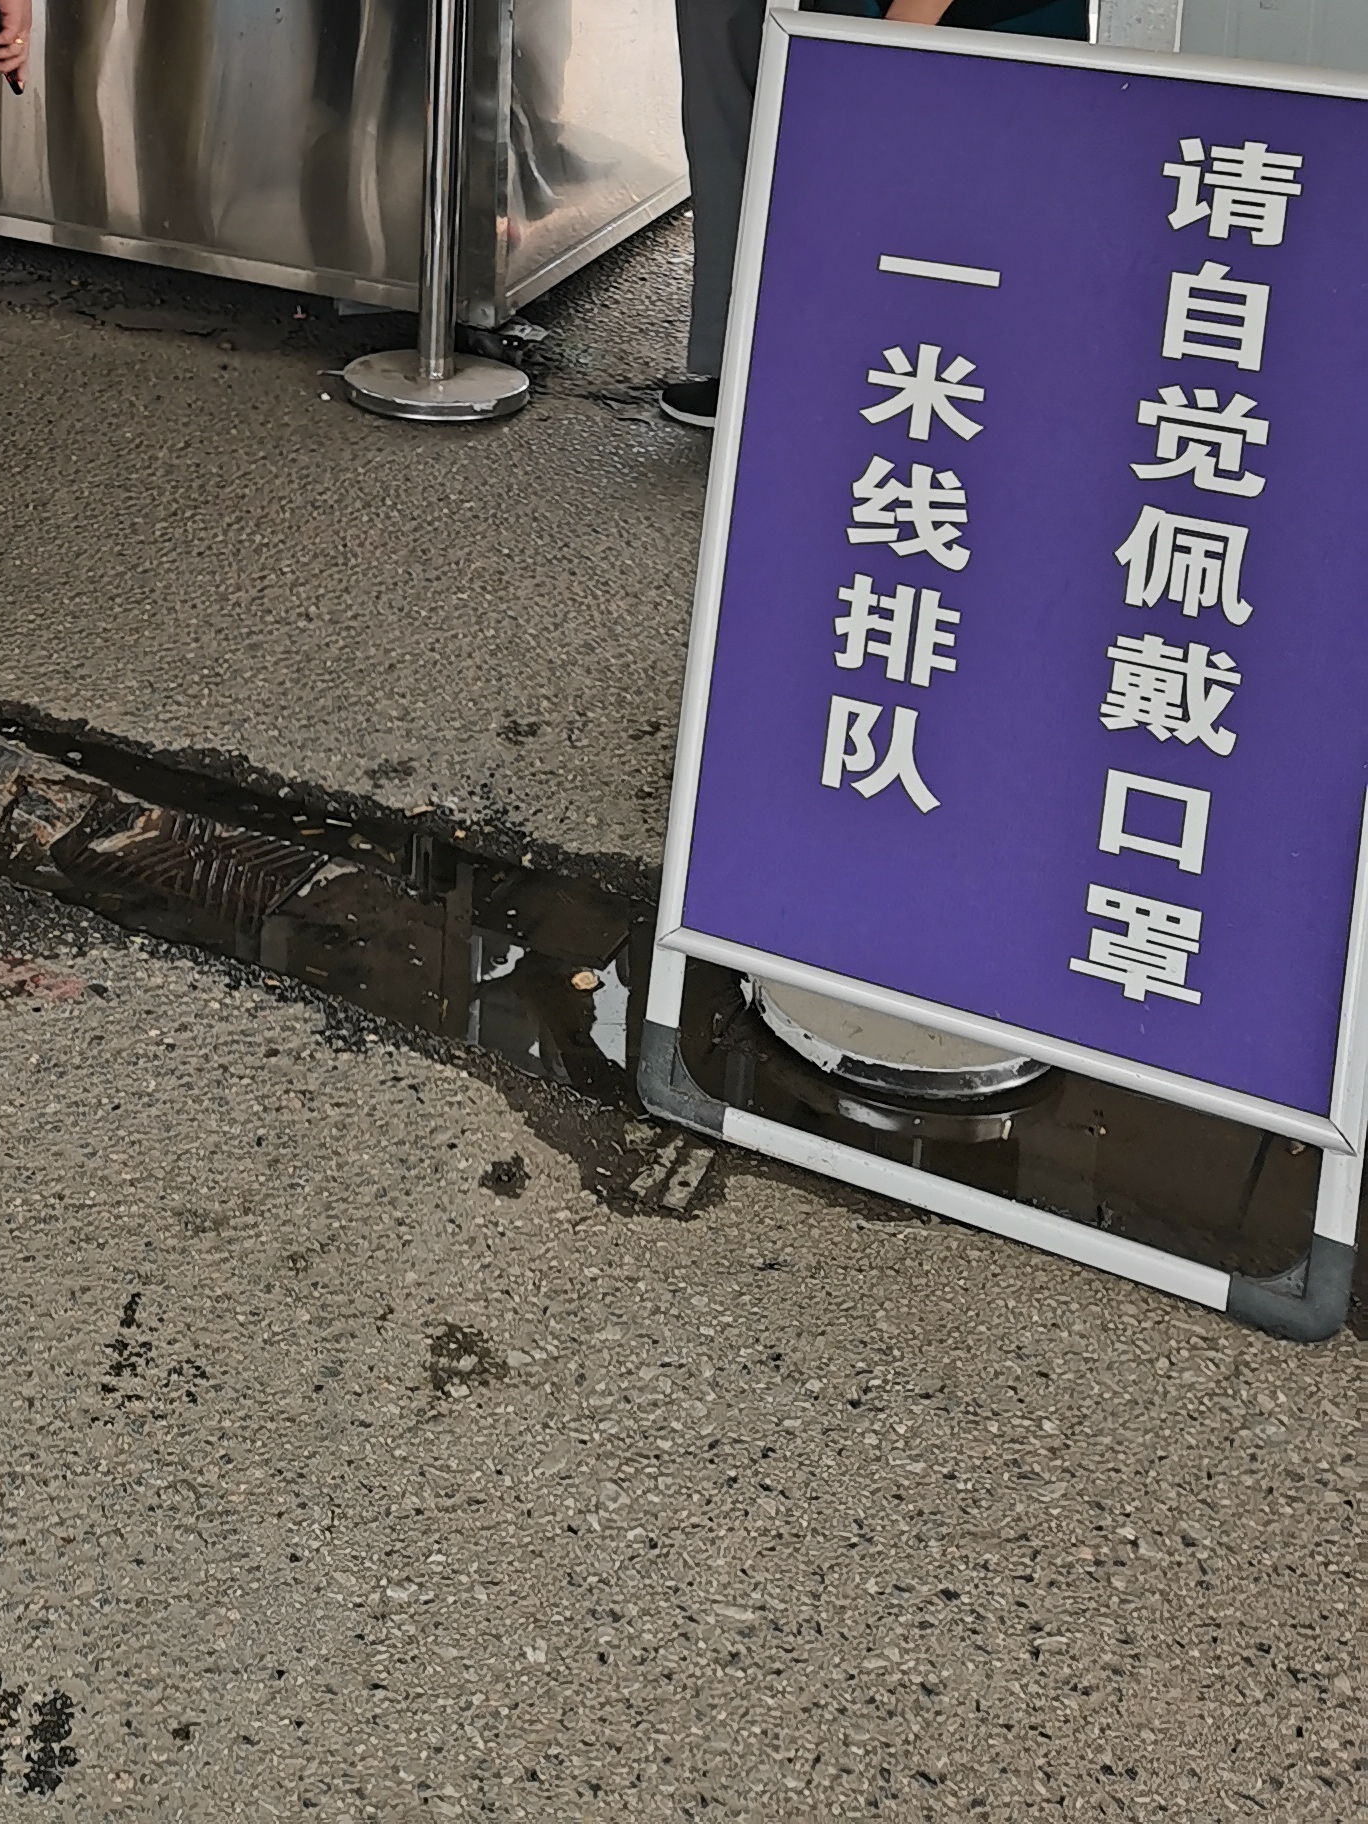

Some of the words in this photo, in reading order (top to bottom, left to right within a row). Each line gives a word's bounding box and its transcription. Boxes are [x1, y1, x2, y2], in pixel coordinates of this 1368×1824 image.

[820, 252, 1002, 816] 一米线排队
[1068, 135, 1305, 1008] 请自觉佩戴口罩
